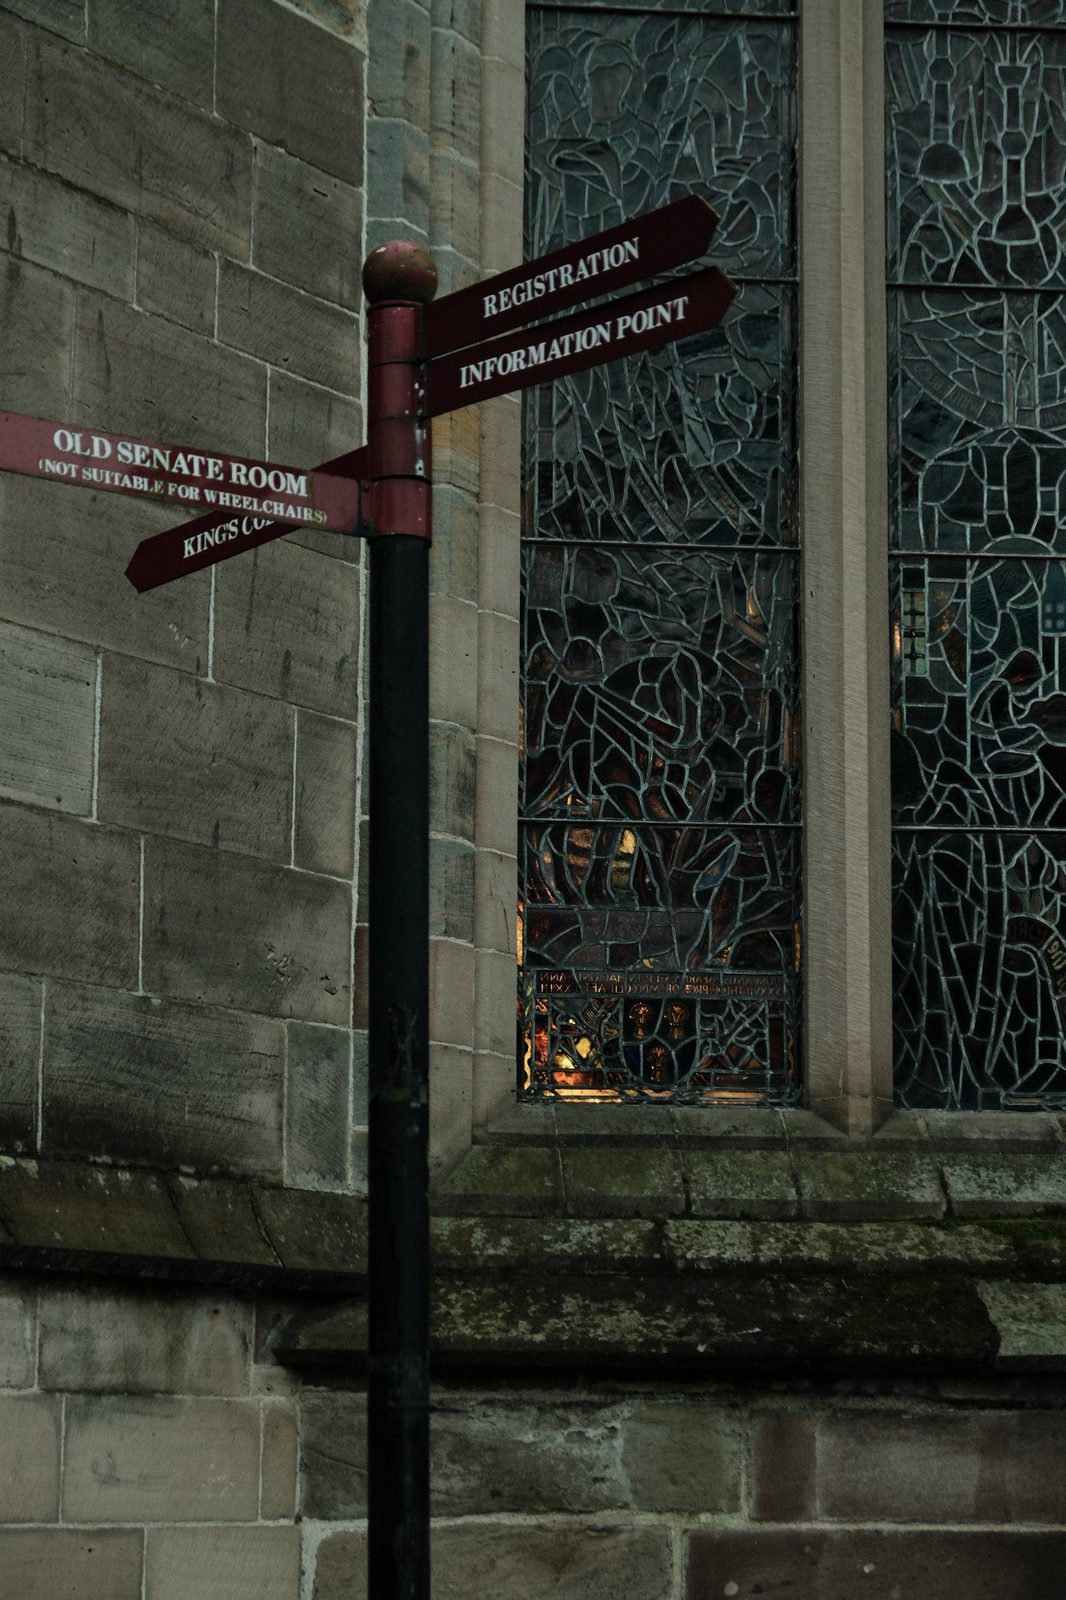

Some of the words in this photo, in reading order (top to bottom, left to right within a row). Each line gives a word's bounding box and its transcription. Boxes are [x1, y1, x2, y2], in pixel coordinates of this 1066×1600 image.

[482, 236, 641, 319] REGISTRATION
[459, 321, 612, 389] INFORMATION
[616, 296, 690, 340] POINT
[38, 458, 78, 478] (NOT
[82, 466, 164, 494] SUITABLE
[167, 483, 200, 501] FOR
[204, 489, 328, 524] WHEELCHAIRS)
[53, 429, 112, 459] OLD
[117, 441, 224, 481] SENATE
[229, 462, 308, 497] ROOM
[183, 518, 239, 559] KING'S
